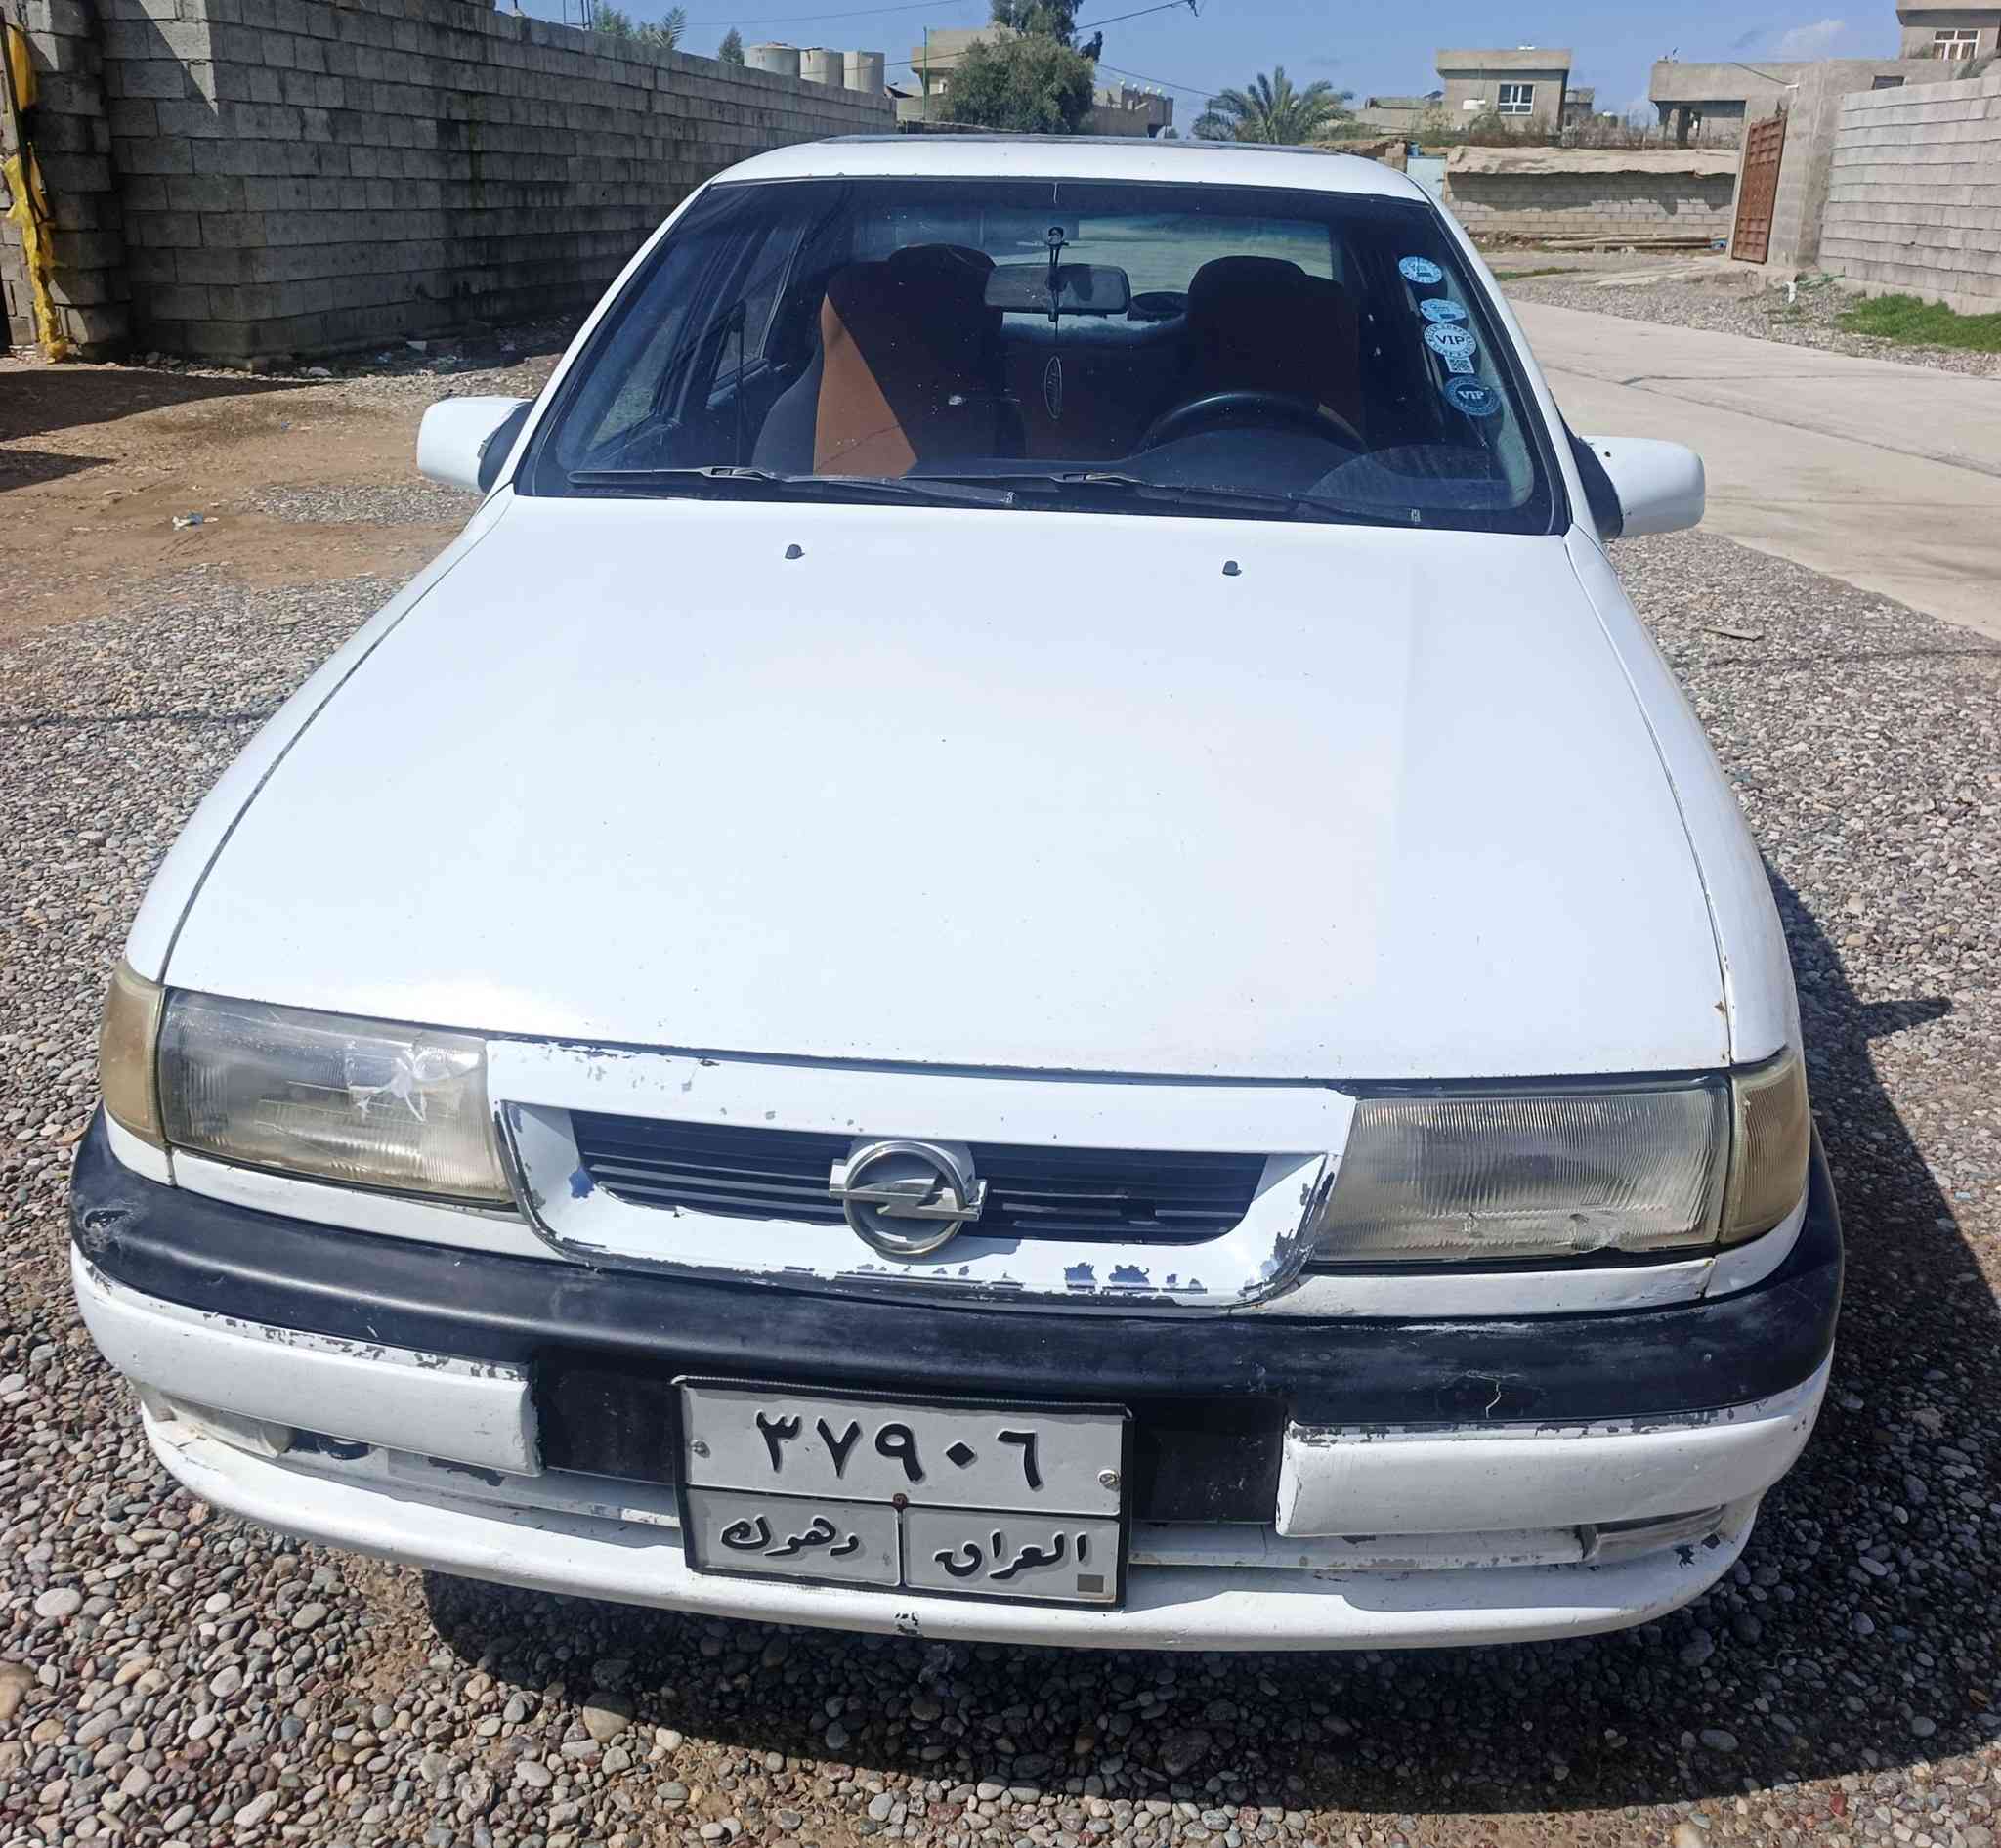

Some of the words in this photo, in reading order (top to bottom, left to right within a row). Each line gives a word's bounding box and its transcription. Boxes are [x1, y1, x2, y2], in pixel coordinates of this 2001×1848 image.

[1435, 334, 1465, 345] VIP
[1457, 390, 1484, 400] VIP
[756, 1410, 1043, 1490] ٣٧٩٠٦
[721, 1515, 859, 1556] دهوك
